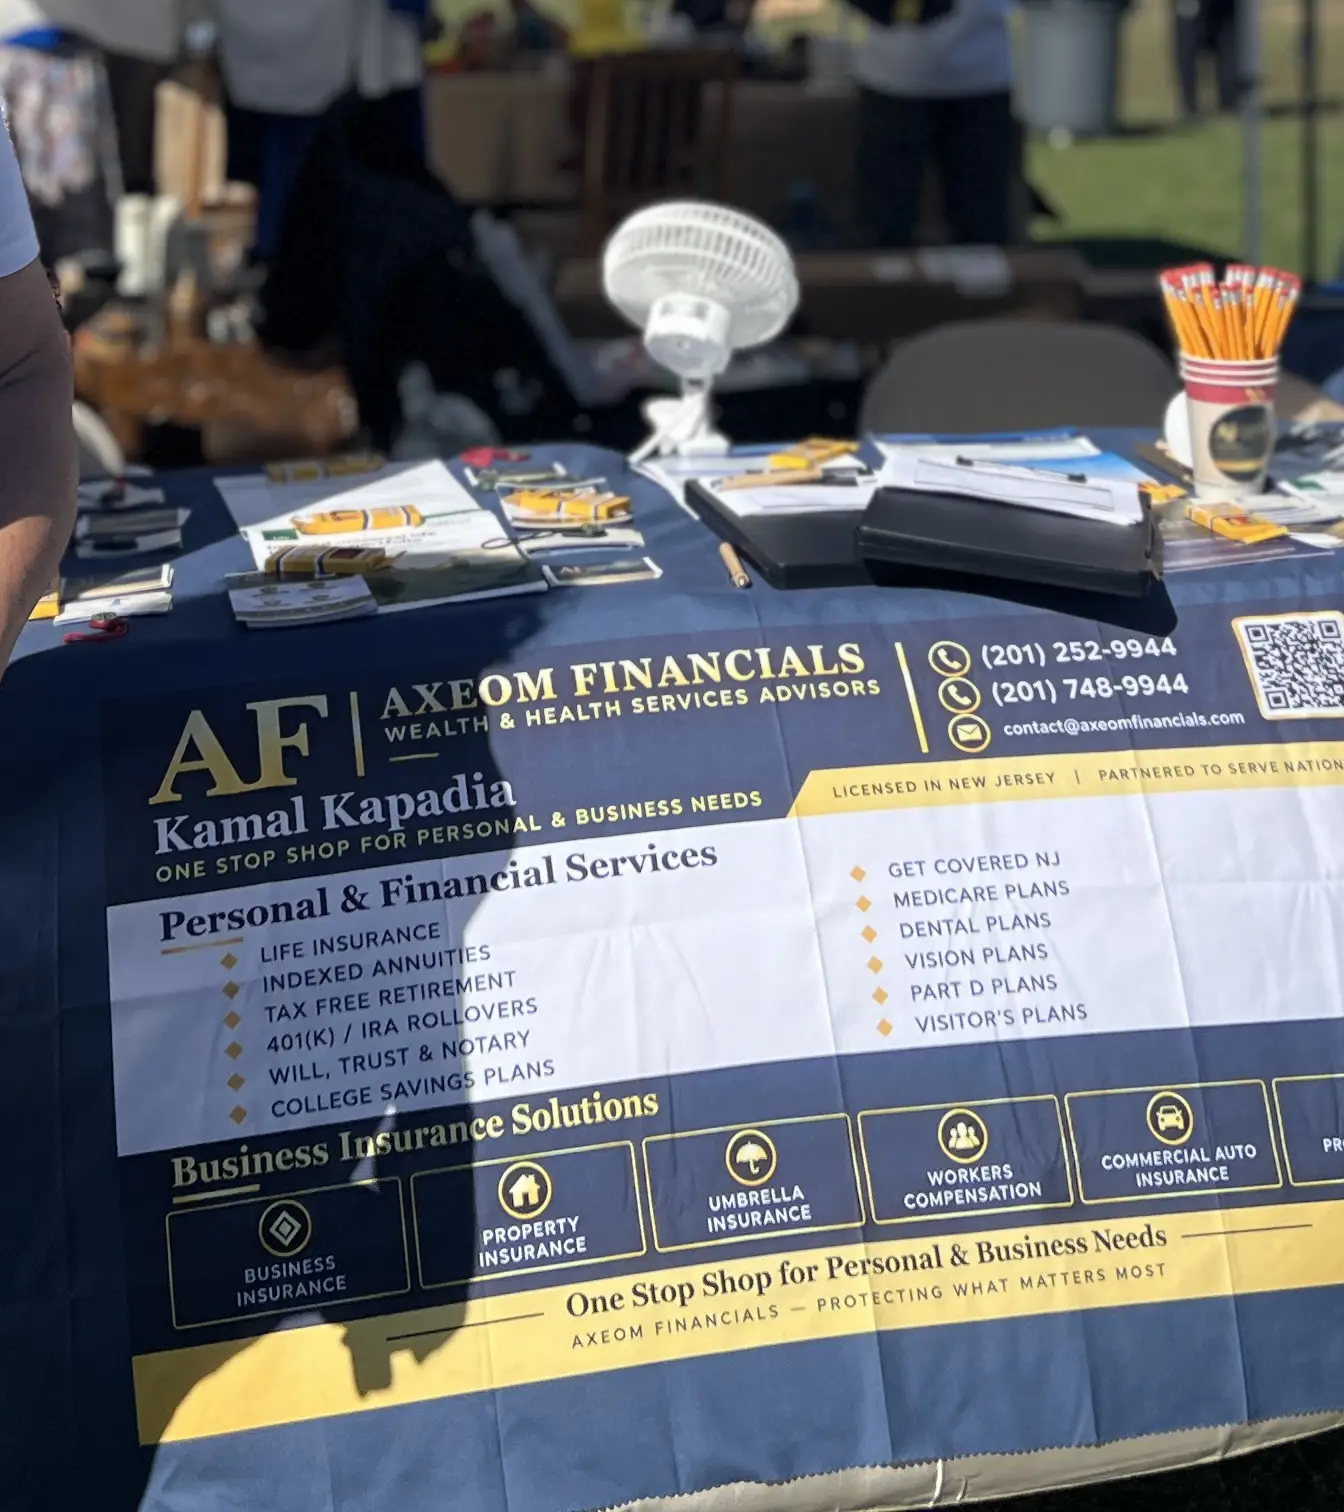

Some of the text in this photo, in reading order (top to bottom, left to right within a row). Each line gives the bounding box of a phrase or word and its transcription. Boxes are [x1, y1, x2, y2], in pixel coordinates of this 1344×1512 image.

[982, 637, 1176, 669] (201) 252-9944
[381, 644, 864, 719] AXEOM FINANCIALS
[992, 674, 1188, 706] (201) 748-9944
[385, 680, 880, 742] WEALTH & HEALTH SERVICES ADVISORS
[1004, 712, 1245, 736] contact@axeomfinancials.com
[149, 695, 328, 804] AF
[833, 782, 916, 798] LICENSED
[924, 780, 941, 791] IN
[949, 776, 985, 790] NEW
[996, 772, 1054, 786] JERSEY
[1098, 766, 1194, 780] PARTNERED
[1200, 764, 1222, 775] TO
[1228, 762, 1278, 774] SERVE
[154, 772, 517, 854] Kamal Kapadia
[156, 791, 761, 882] ONE STOP SHOP FOR PERSONAL & BUSINESS NEEDS
[888, 852, 1059, 877] GET COVERED NJ
[160, 844, 717, 941] Personal & Financial Services
[894, 881, 1069, 908] MEDICARE PLANS
[900, 913, 1051, 938] DENTAL PLANS
[261, 922, 440, 962] LIFE INSURANCE
[905, 944, 1047, 968] VISION PLANS
[264, 945, 490, 992] INDEXED ANNUITIES
[265, 971, 515, 1022] TAX FREE RETIREMENT
[911, 975, 1057, 1001] PART D PLANS
[267, 998, 537, 1052] 401(K) / IRA ROLLOVERS
[915, 1004, 1087, 1032] VISITOR'S PLANS
[269, 1030, 529, 1084] WILL, TRUST & NOTARY
[272, 1060, 554, 1117] COLLEGE SAVINGS PLANS
[173, 1092, 658, 1187] Business Insurance Solutions
[1102, 1144, 1256, 1170] COMMERCIAL AUTO
[928, 1164, 1012, 1186] WORKERS
[1136, 1166, 1229, 1187] INSURANCE
[709, 1186, 804, 1211] UMBRELLA
[904, 1182, 1041, 1208] COMPENSATION
[483, 1216, 578, 1245] PROPERTY
[708, 1205, 811, 1232] INSURANCE
[479, 1236, 586, 1267] INSURANCE
[565, 1225, 1166, 1316] One Stop Shop for Personal & Business Needs
